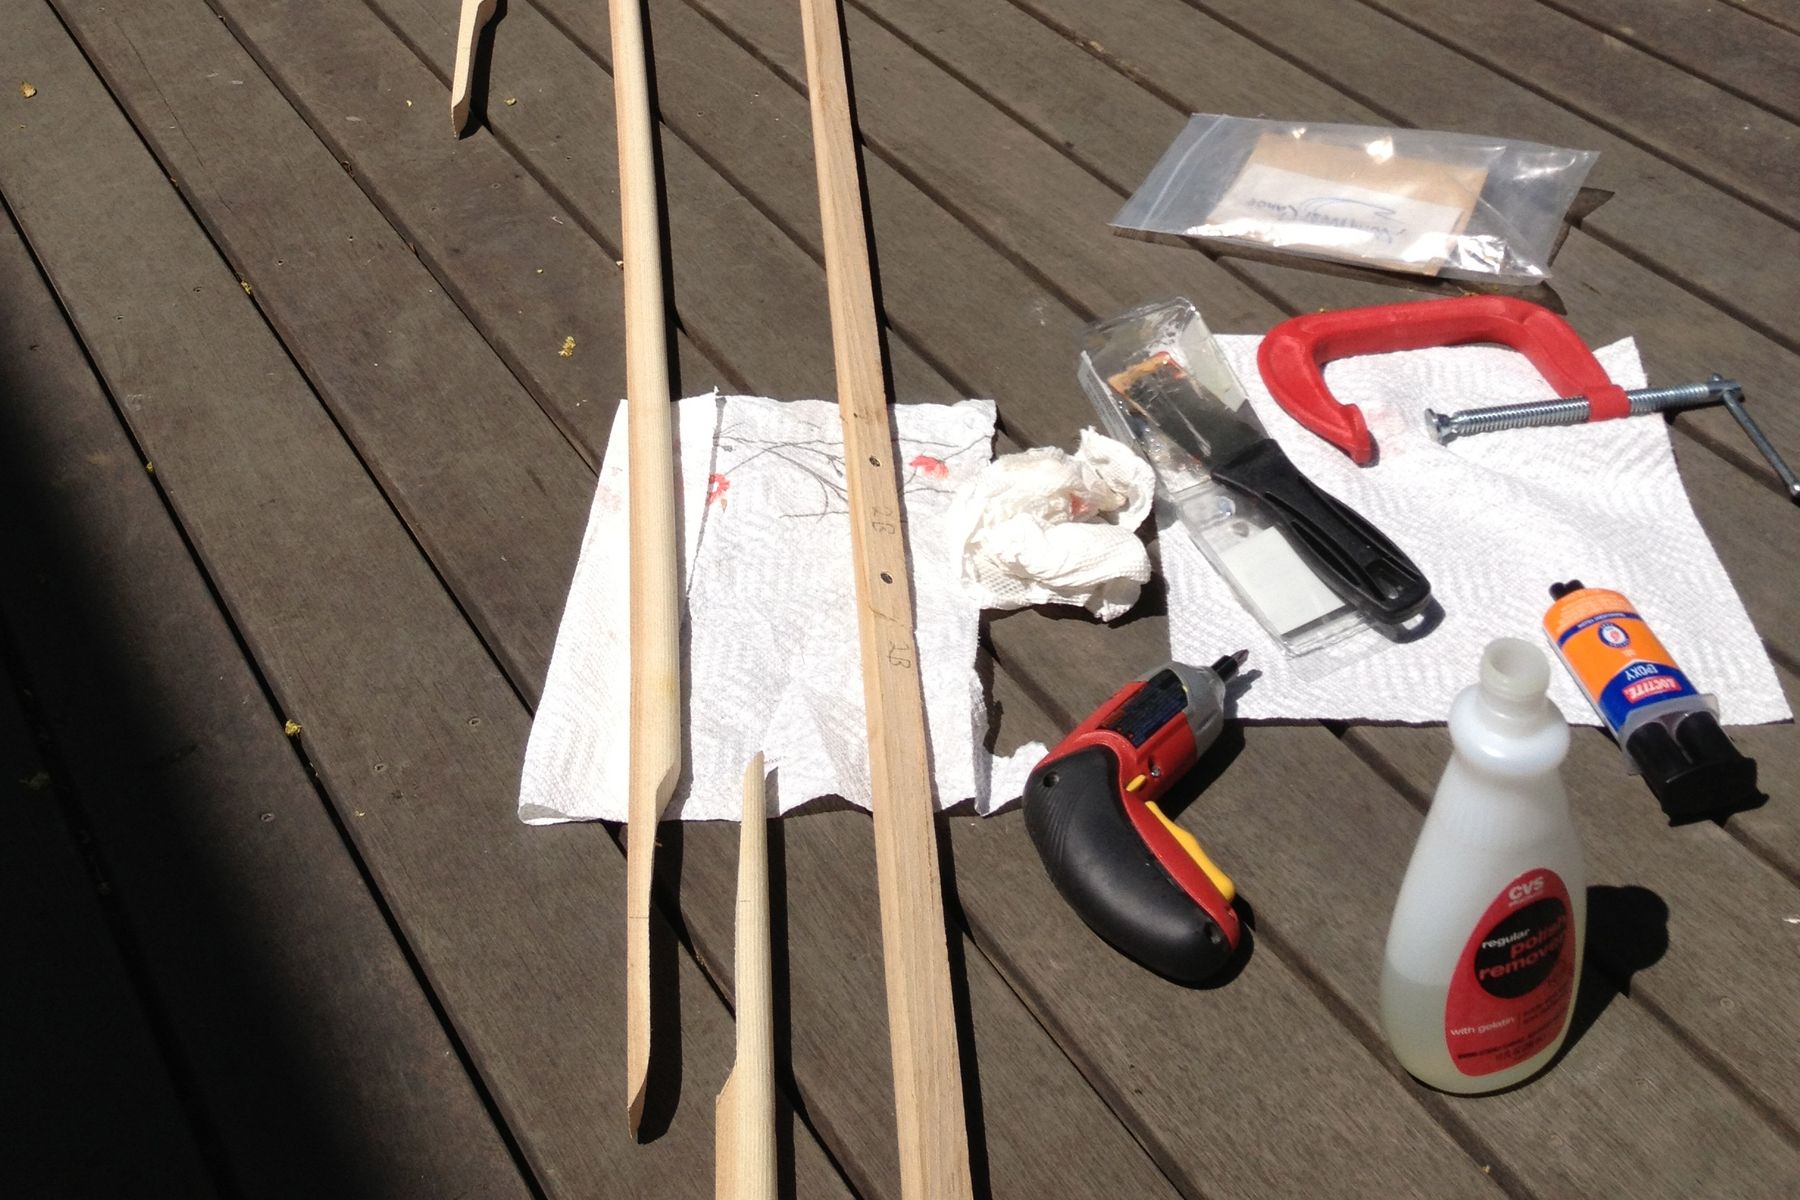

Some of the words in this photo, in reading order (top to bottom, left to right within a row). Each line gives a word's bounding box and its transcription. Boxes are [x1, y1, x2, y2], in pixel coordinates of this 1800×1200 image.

[1625, 663, 1659, 681] EPOXY
[1628, 677, 1679, 702] LOCTITE
[1508, 876, 1545, 901] CVS
[1481, 928, 1530, 949] regular
[1450, 1025, 1475, 1037] with
